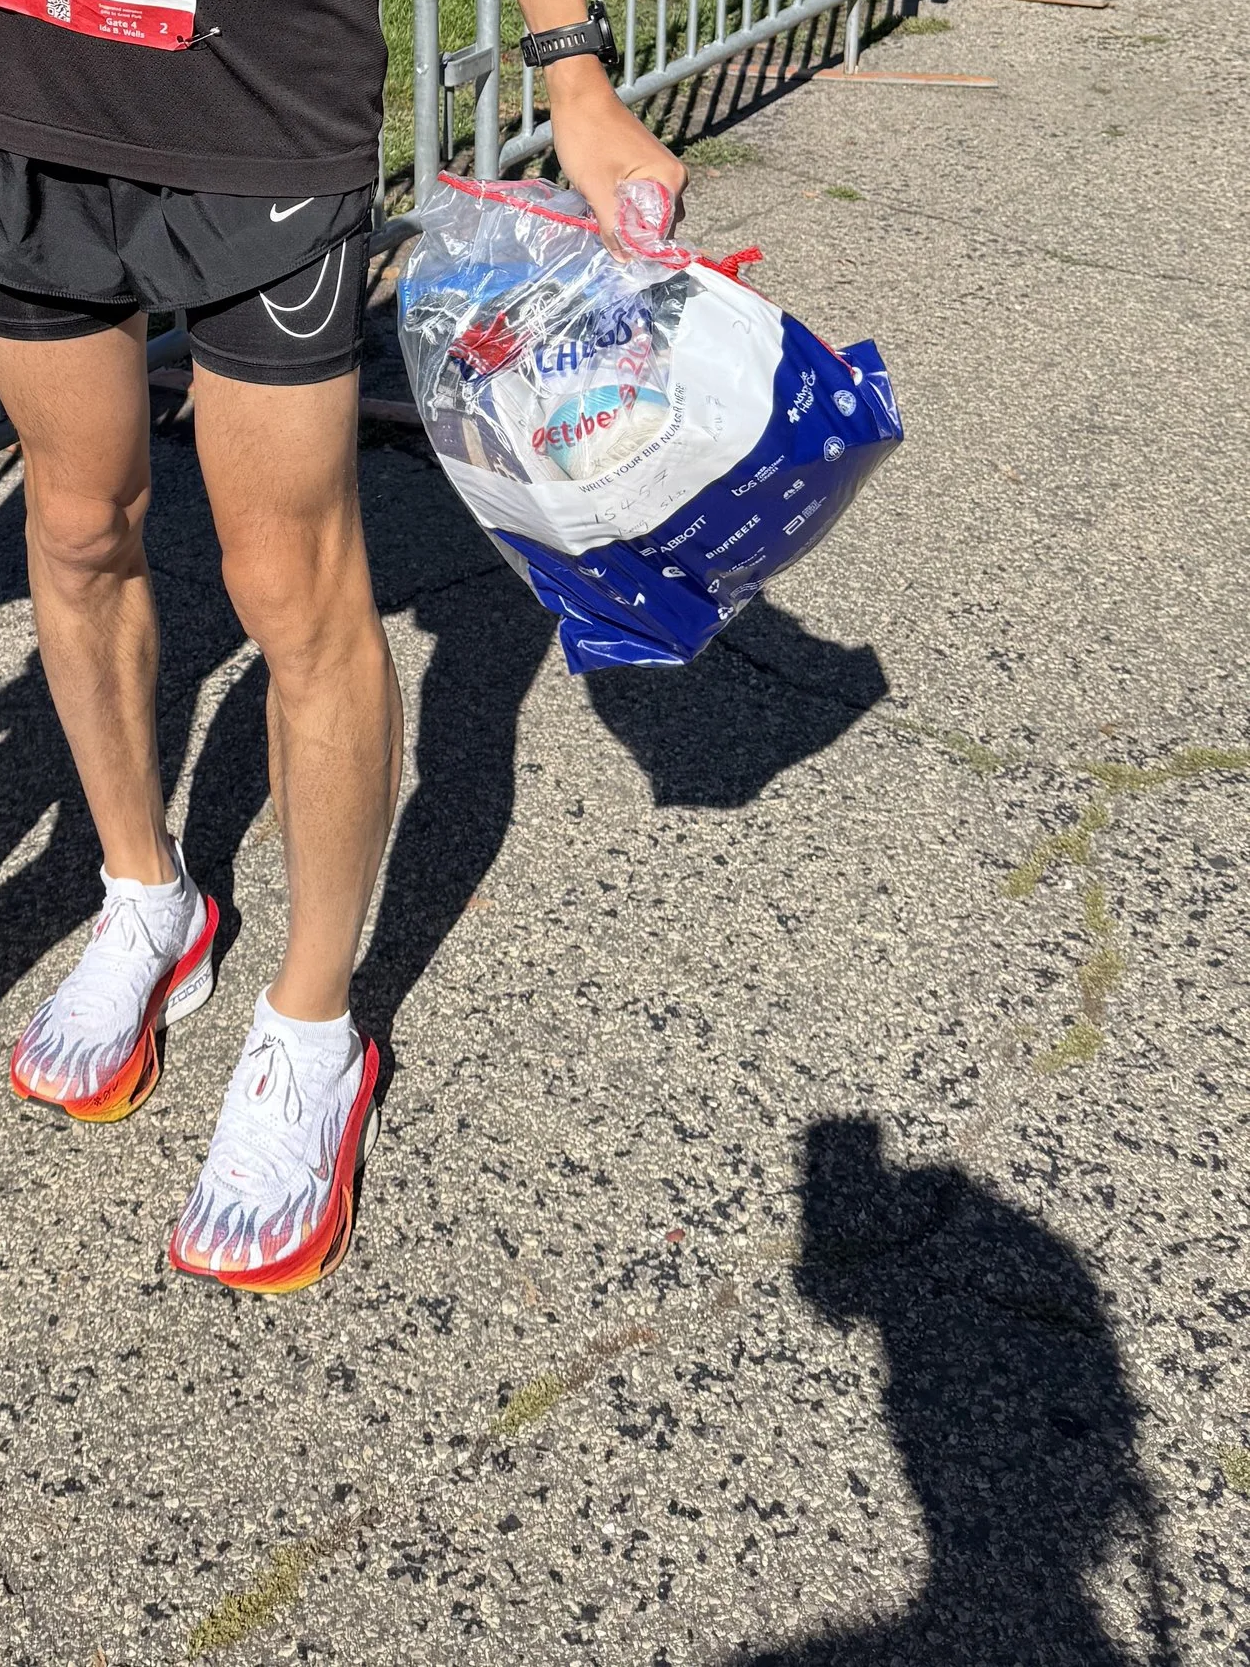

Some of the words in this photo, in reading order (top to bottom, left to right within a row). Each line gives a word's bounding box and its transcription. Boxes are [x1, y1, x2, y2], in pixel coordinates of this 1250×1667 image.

[99, 24, 111, 33] Ida
[123, 28, 145, 39] Wells
[105, 17, 129, 28] Gate
[130, 21, 138, 29] 4
[159, 22, 169, 34] 2
[579, 473, 614, 494] WRITE
[615, 455, 644, 478] YOUR
[642, 442, 661, 458] BIB
[660, 514, 707, 554] ABBOTT
[705, 514, 761, 560] BIOFREEZE
